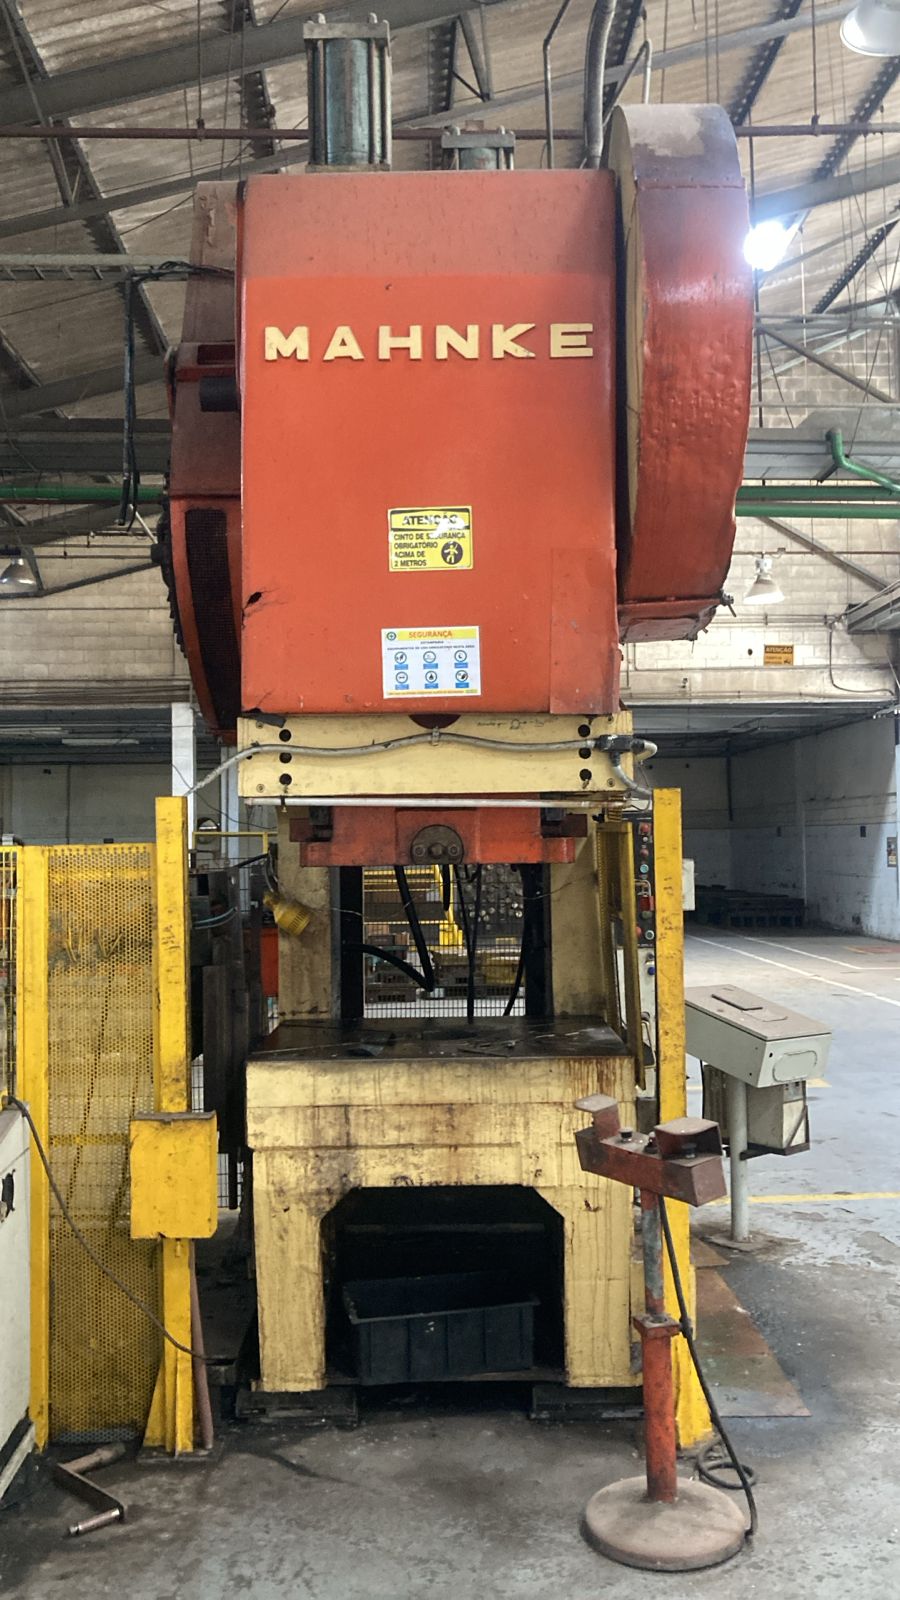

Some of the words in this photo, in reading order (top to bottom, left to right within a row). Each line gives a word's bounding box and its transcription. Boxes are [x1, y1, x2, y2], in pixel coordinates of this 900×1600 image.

[264, 322, 594, 361] MAHNKE
[393, 533, 414, 541] CINTO
[426, 532, 466, 541] SURANÇA
[408, 630, 453, 639] SEGURANÇA
